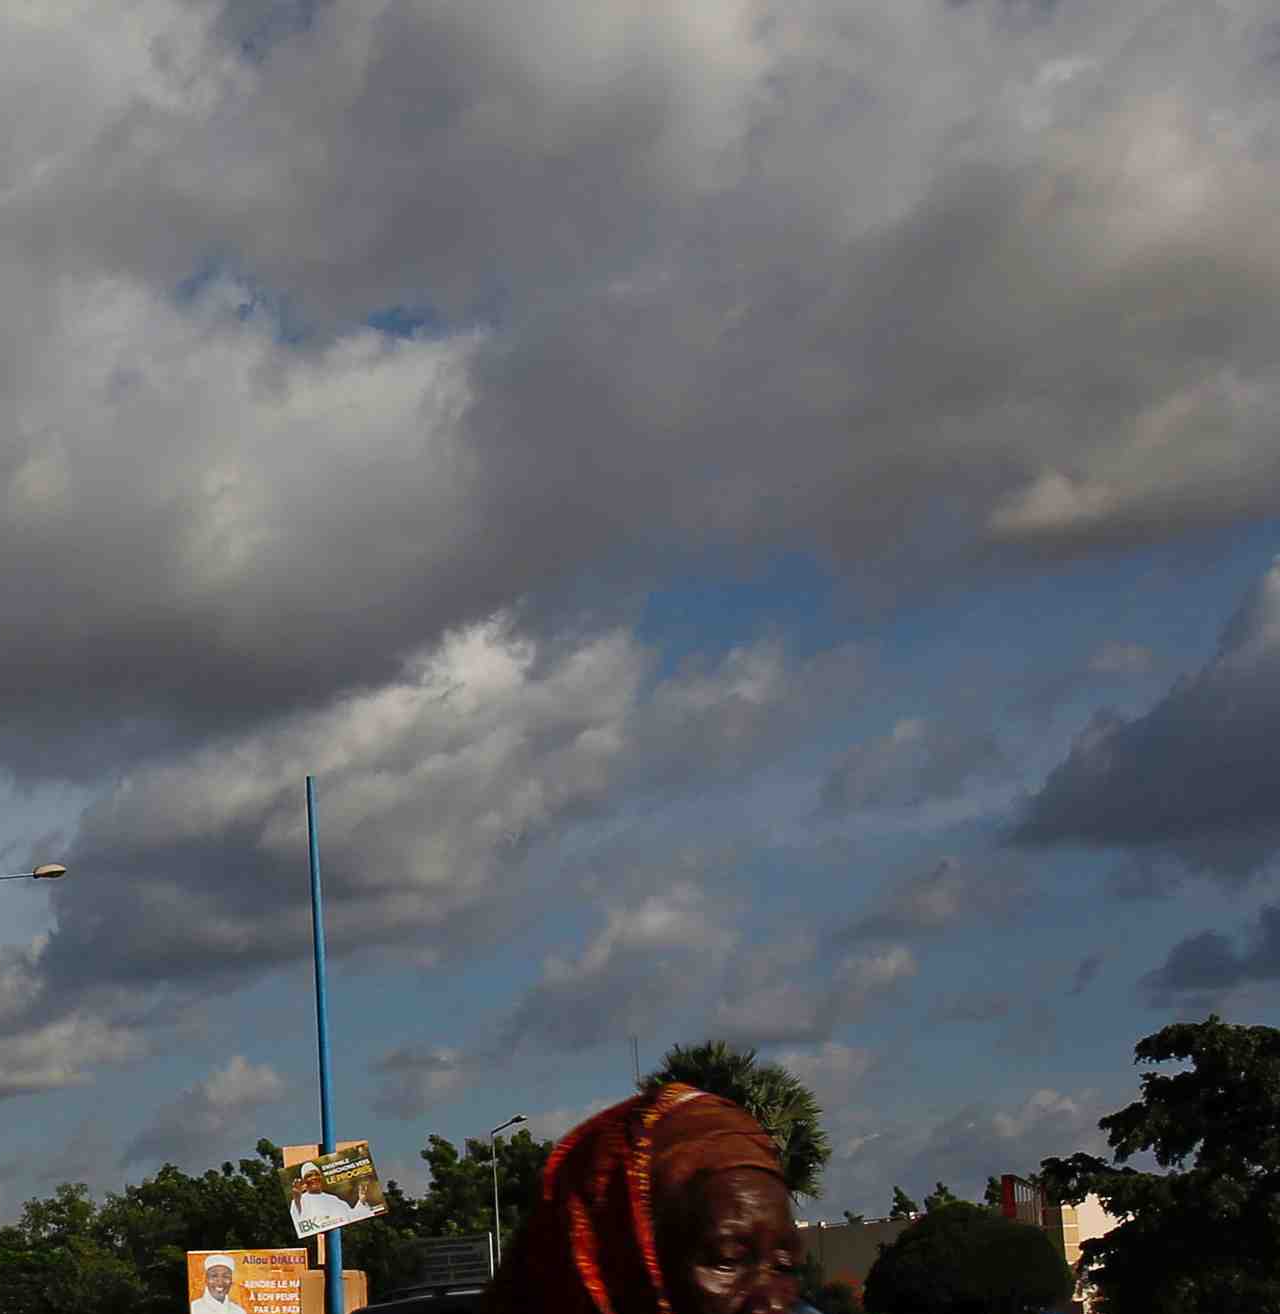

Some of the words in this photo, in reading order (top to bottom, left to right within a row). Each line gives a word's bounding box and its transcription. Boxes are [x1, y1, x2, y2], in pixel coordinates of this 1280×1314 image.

[299, 1219, 320, 1234] IBK
[243, 1255, 268, 1265] Aliou
[277, 1279, 288, 1288] LE
[275, 1292, 301, 1301] PEUPL
[271, 1305, 281, 1313] LA
